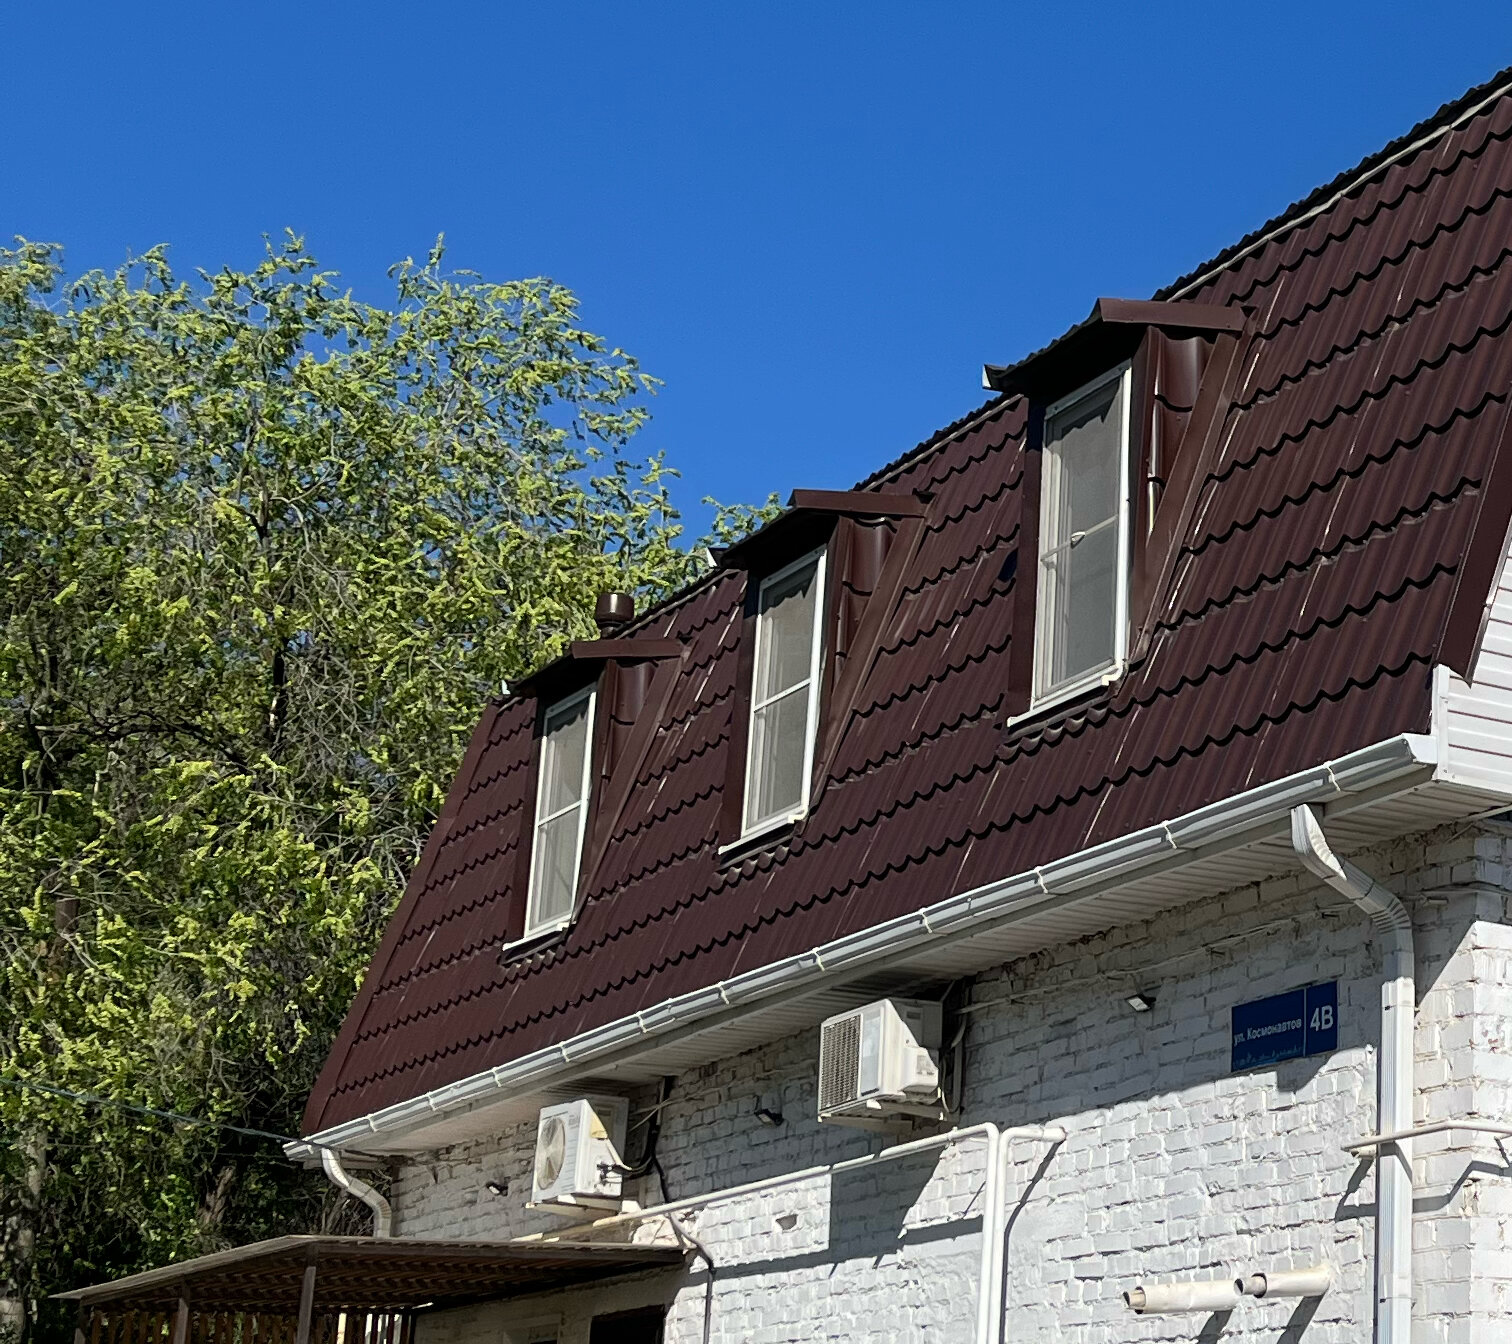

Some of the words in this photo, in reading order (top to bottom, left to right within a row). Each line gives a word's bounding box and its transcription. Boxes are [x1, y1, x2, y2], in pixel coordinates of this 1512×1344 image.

[1233, 1033, 1246, 1047] ул.
[1247, 1018, 1302, 1040] Космонавтов
[1310, 1005, 1334, 1031] 4В
